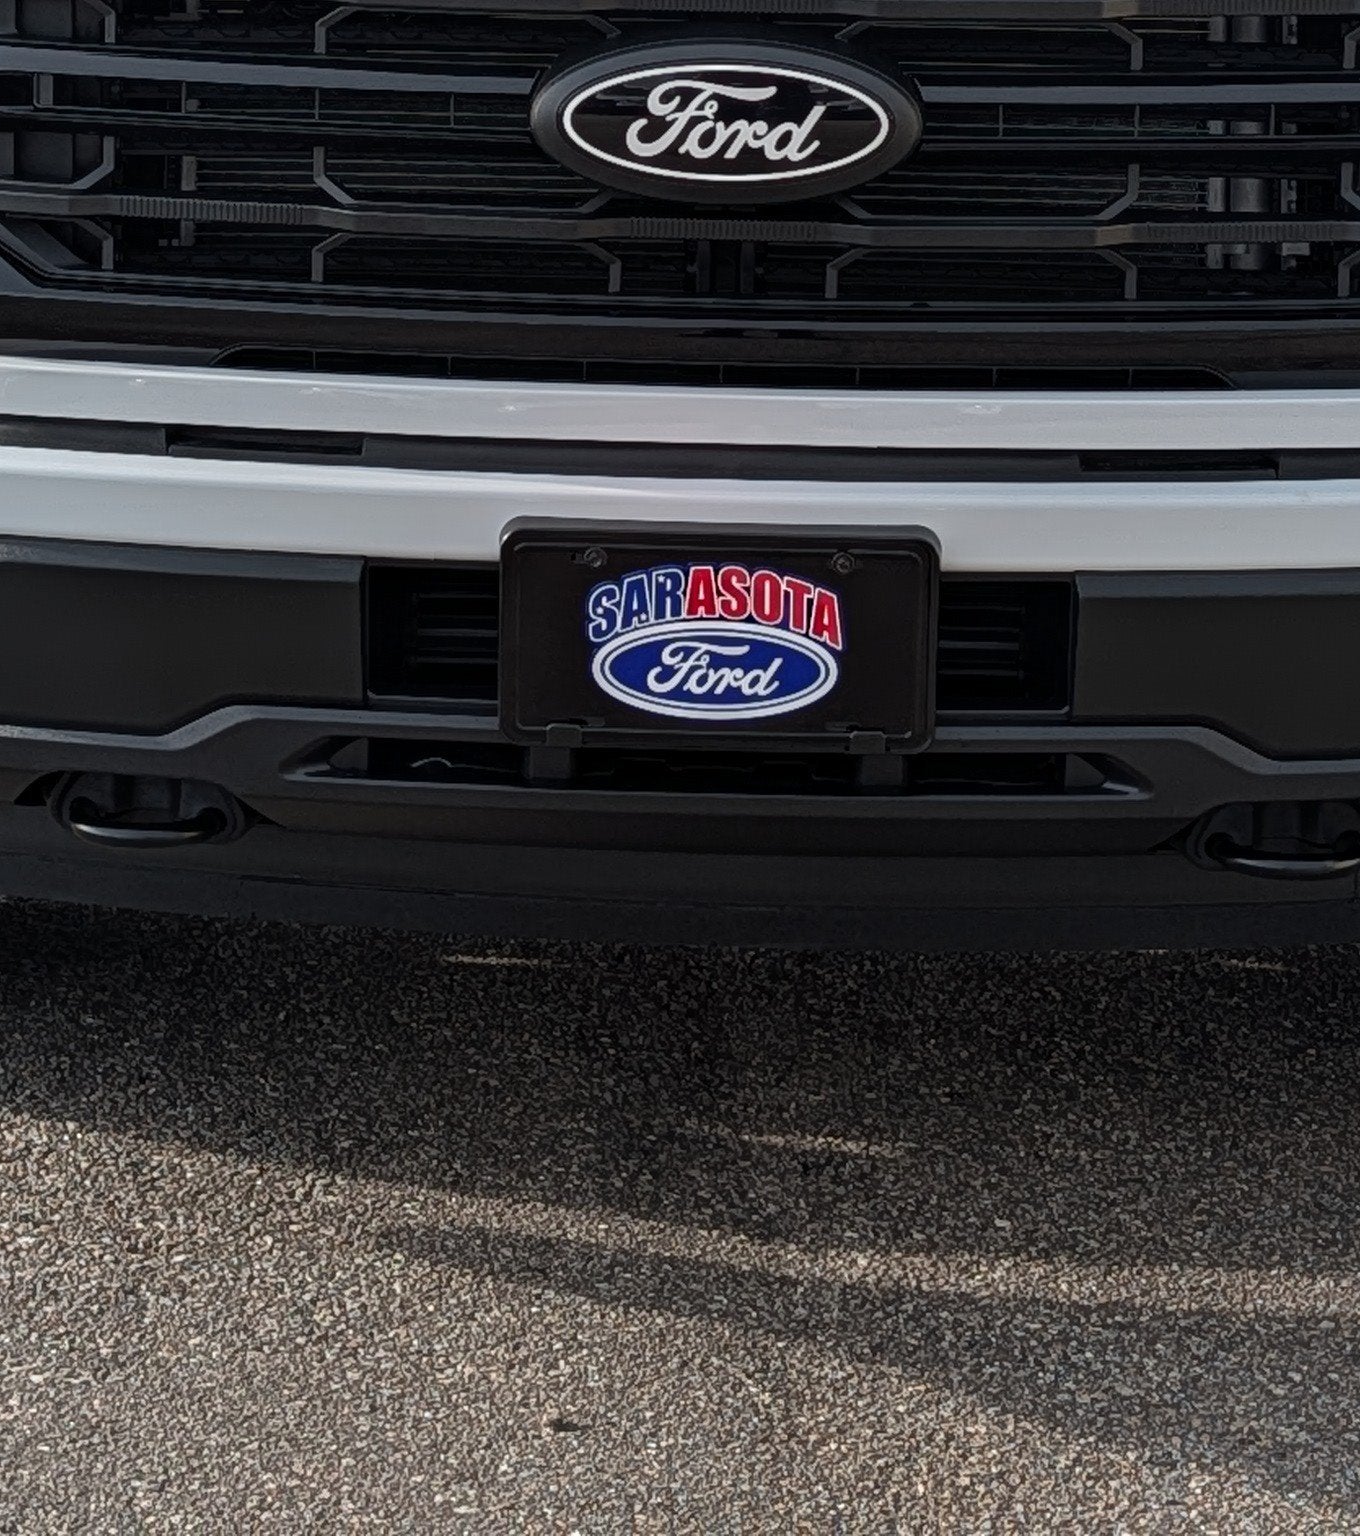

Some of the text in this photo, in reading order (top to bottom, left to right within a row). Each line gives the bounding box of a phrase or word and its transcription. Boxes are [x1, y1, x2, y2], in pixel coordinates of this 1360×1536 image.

[625, 79, 827, 162] Ford
[587, 566, 843, 651] SARASOTA
[646, 640, 782, 697] Ford
